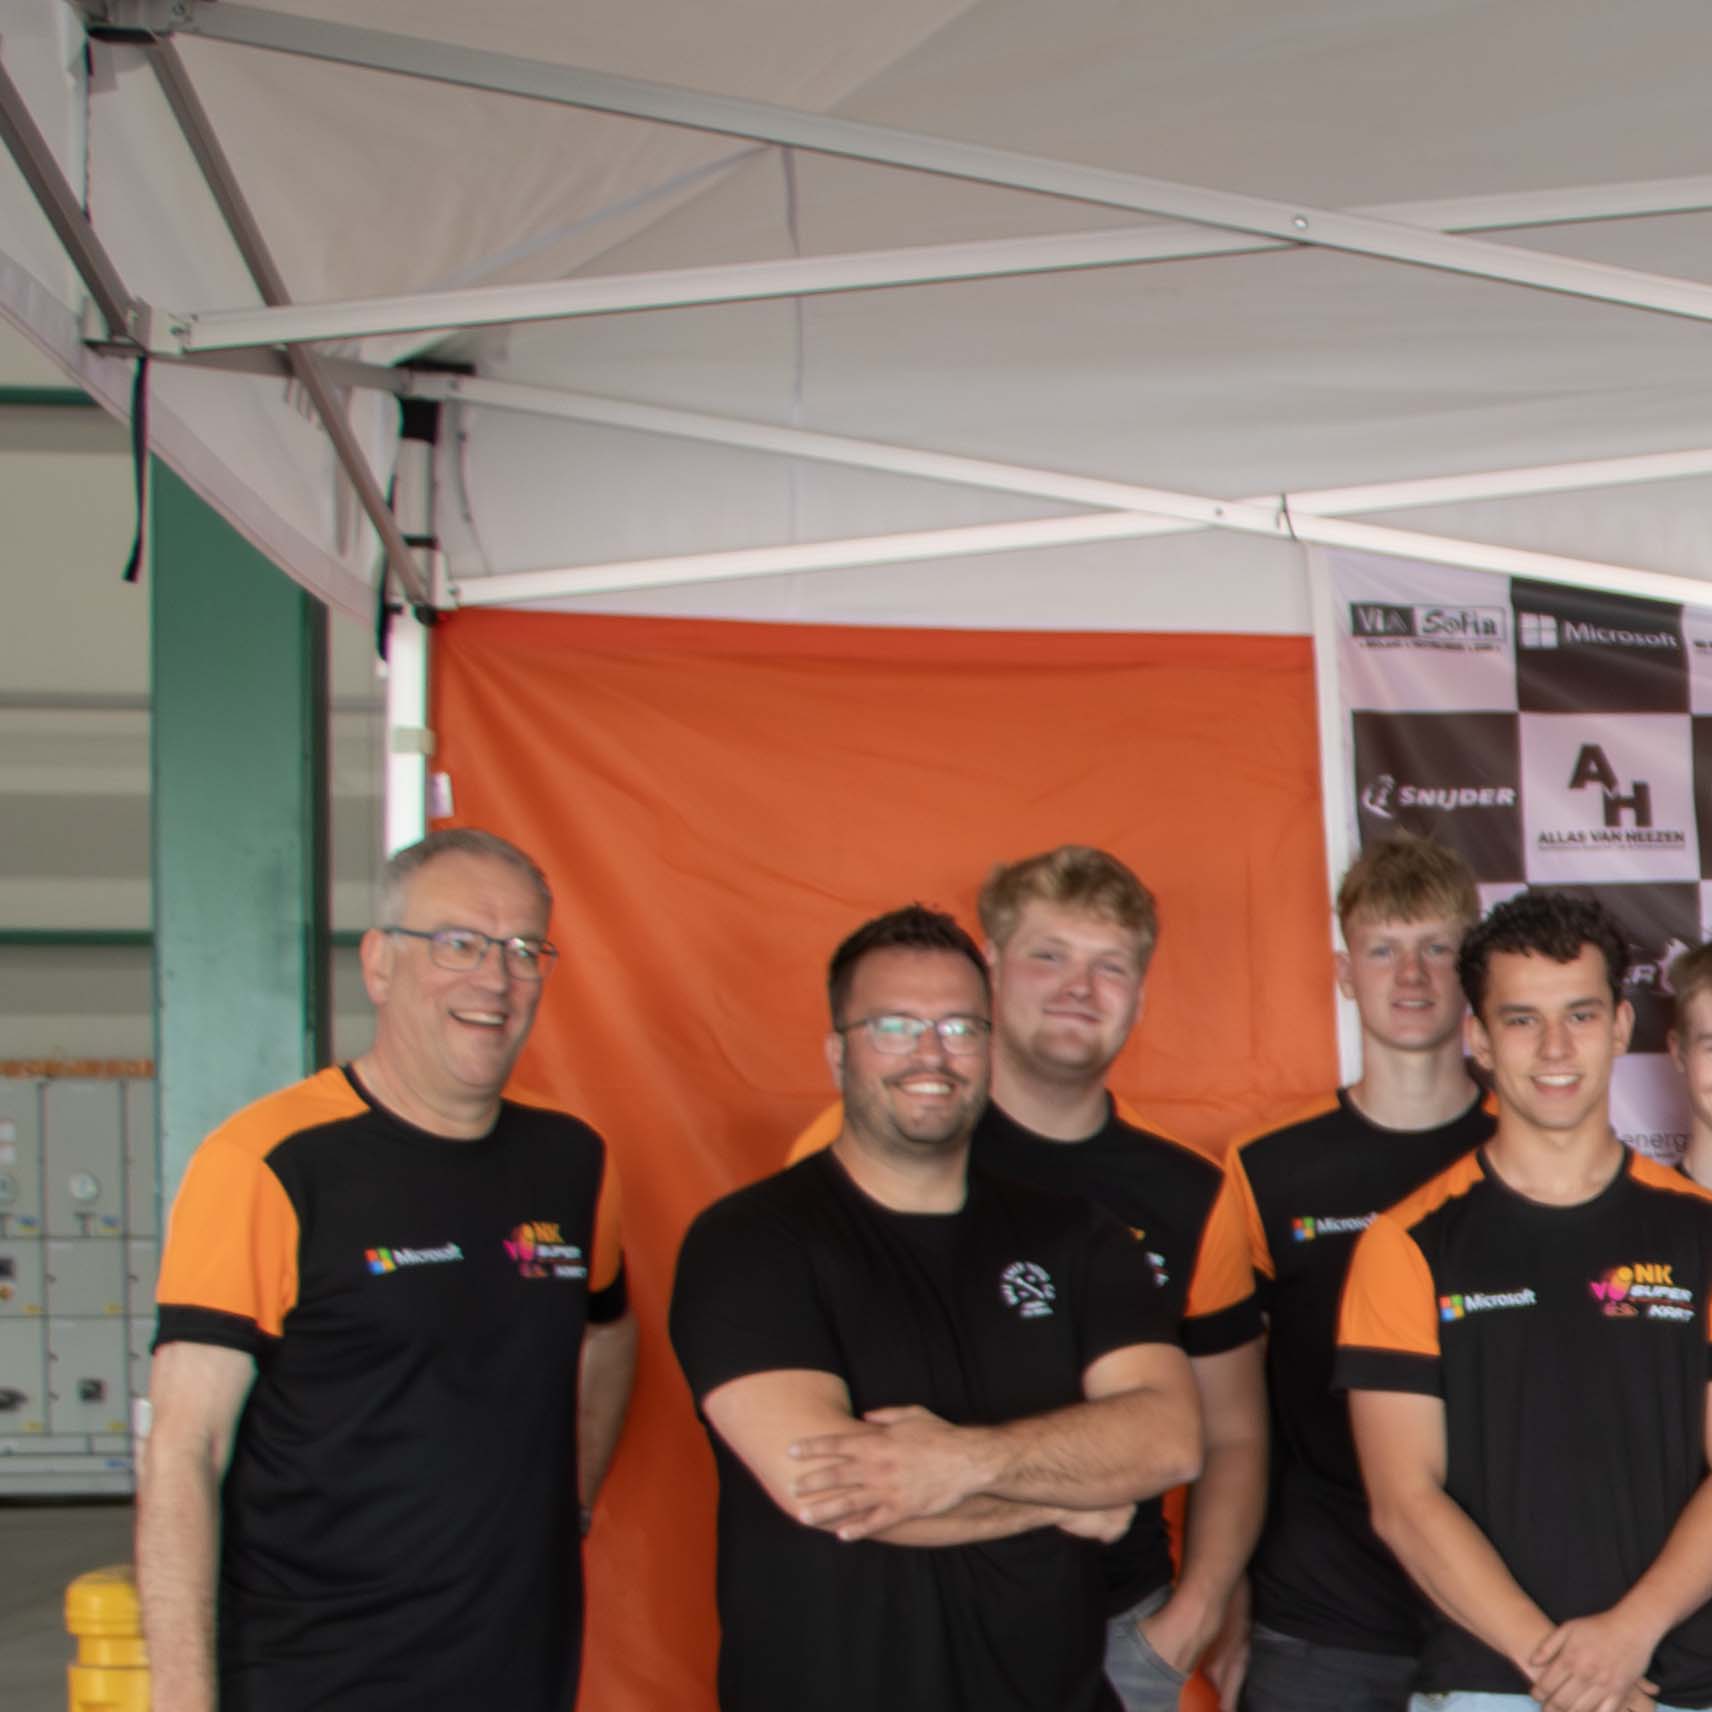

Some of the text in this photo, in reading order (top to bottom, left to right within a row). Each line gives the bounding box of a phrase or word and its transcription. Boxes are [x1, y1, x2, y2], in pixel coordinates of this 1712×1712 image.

[1564, 620, 1677, 648] Microsoft
[1399, 785, 1518, 811] SNIJDER
[1591, 832, 1622, 845] VAN
[1622, 1131, 1689, 1153] energ
[1464, 1288, 1536, 1312] Microsoft
[1629, 1285, 1692, 1301] SUPER
